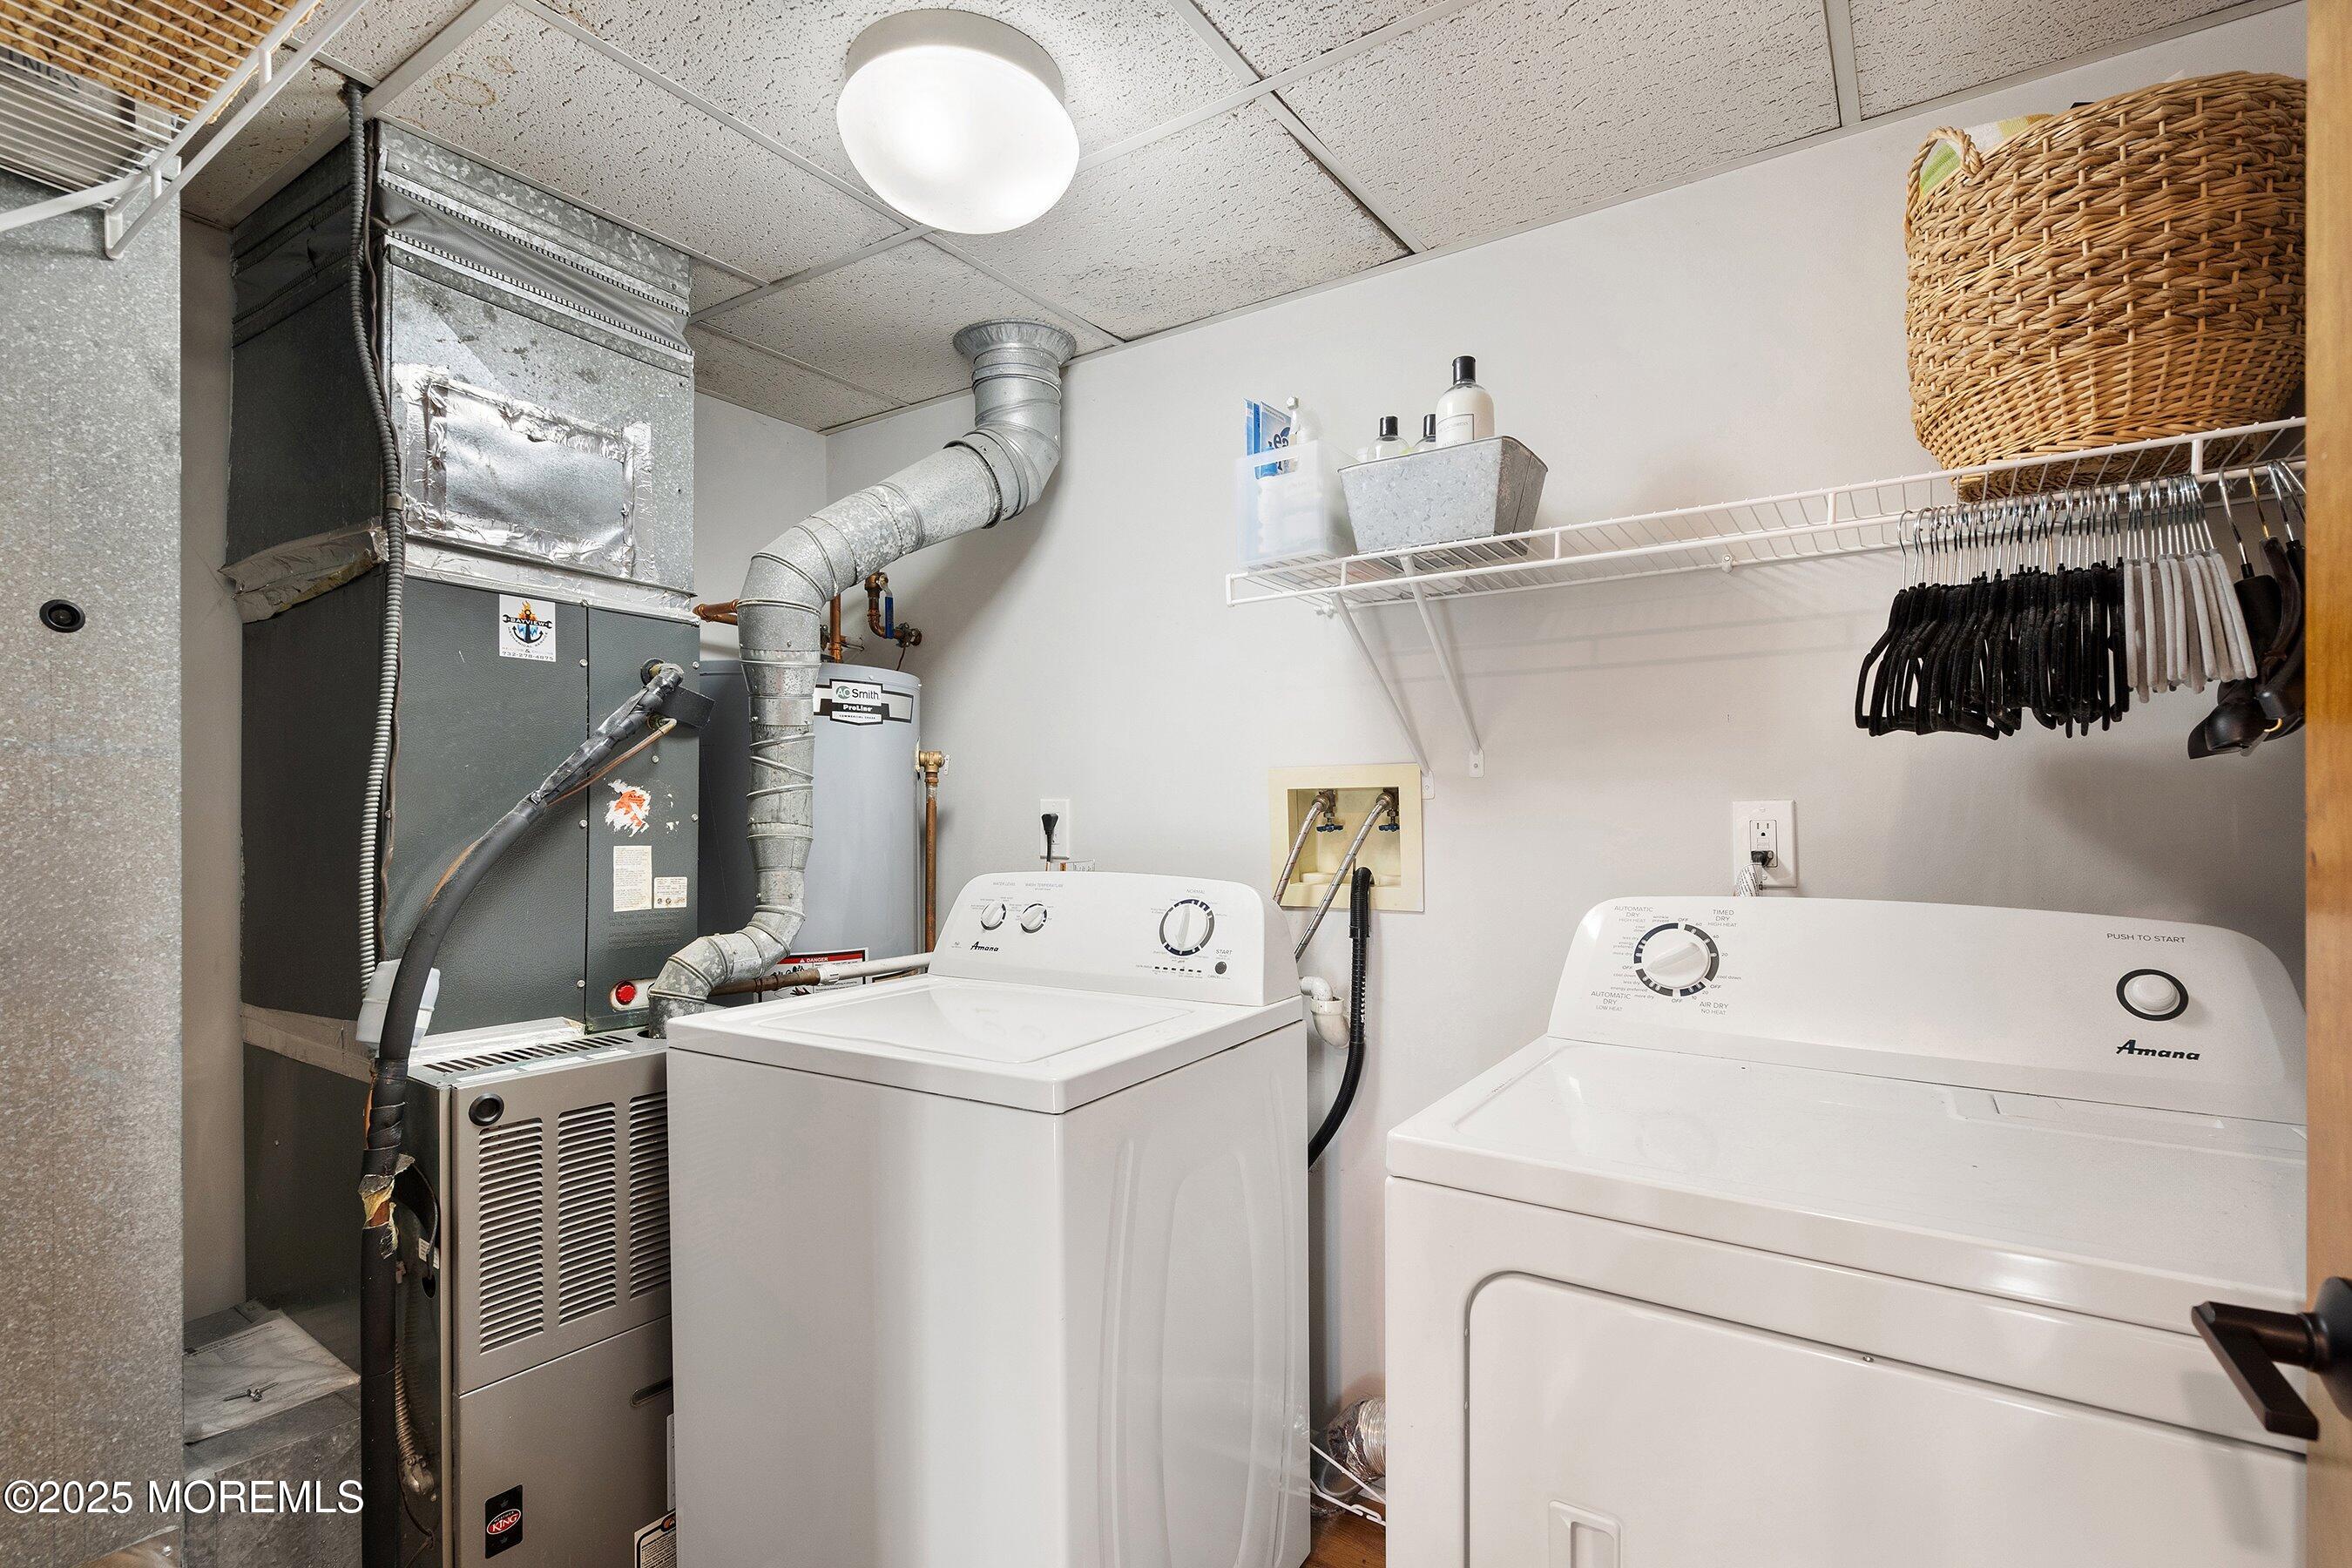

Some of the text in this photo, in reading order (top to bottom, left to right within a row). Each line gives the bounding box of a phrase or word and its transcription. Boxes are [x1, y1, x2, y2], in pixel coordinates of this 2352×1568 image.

[510, 617, 545, 626] BAYVIEW
[851, 687, 880, 700] Smith
[842, 704, 873, 713] ProLine
[970, 941, 999, 952] Amana
[1591, 990, 1632, 1000] AUTOMATIC
[2116, 1039, 2200, 1061] Amana
[492, 1513, 519, 1532] KING
